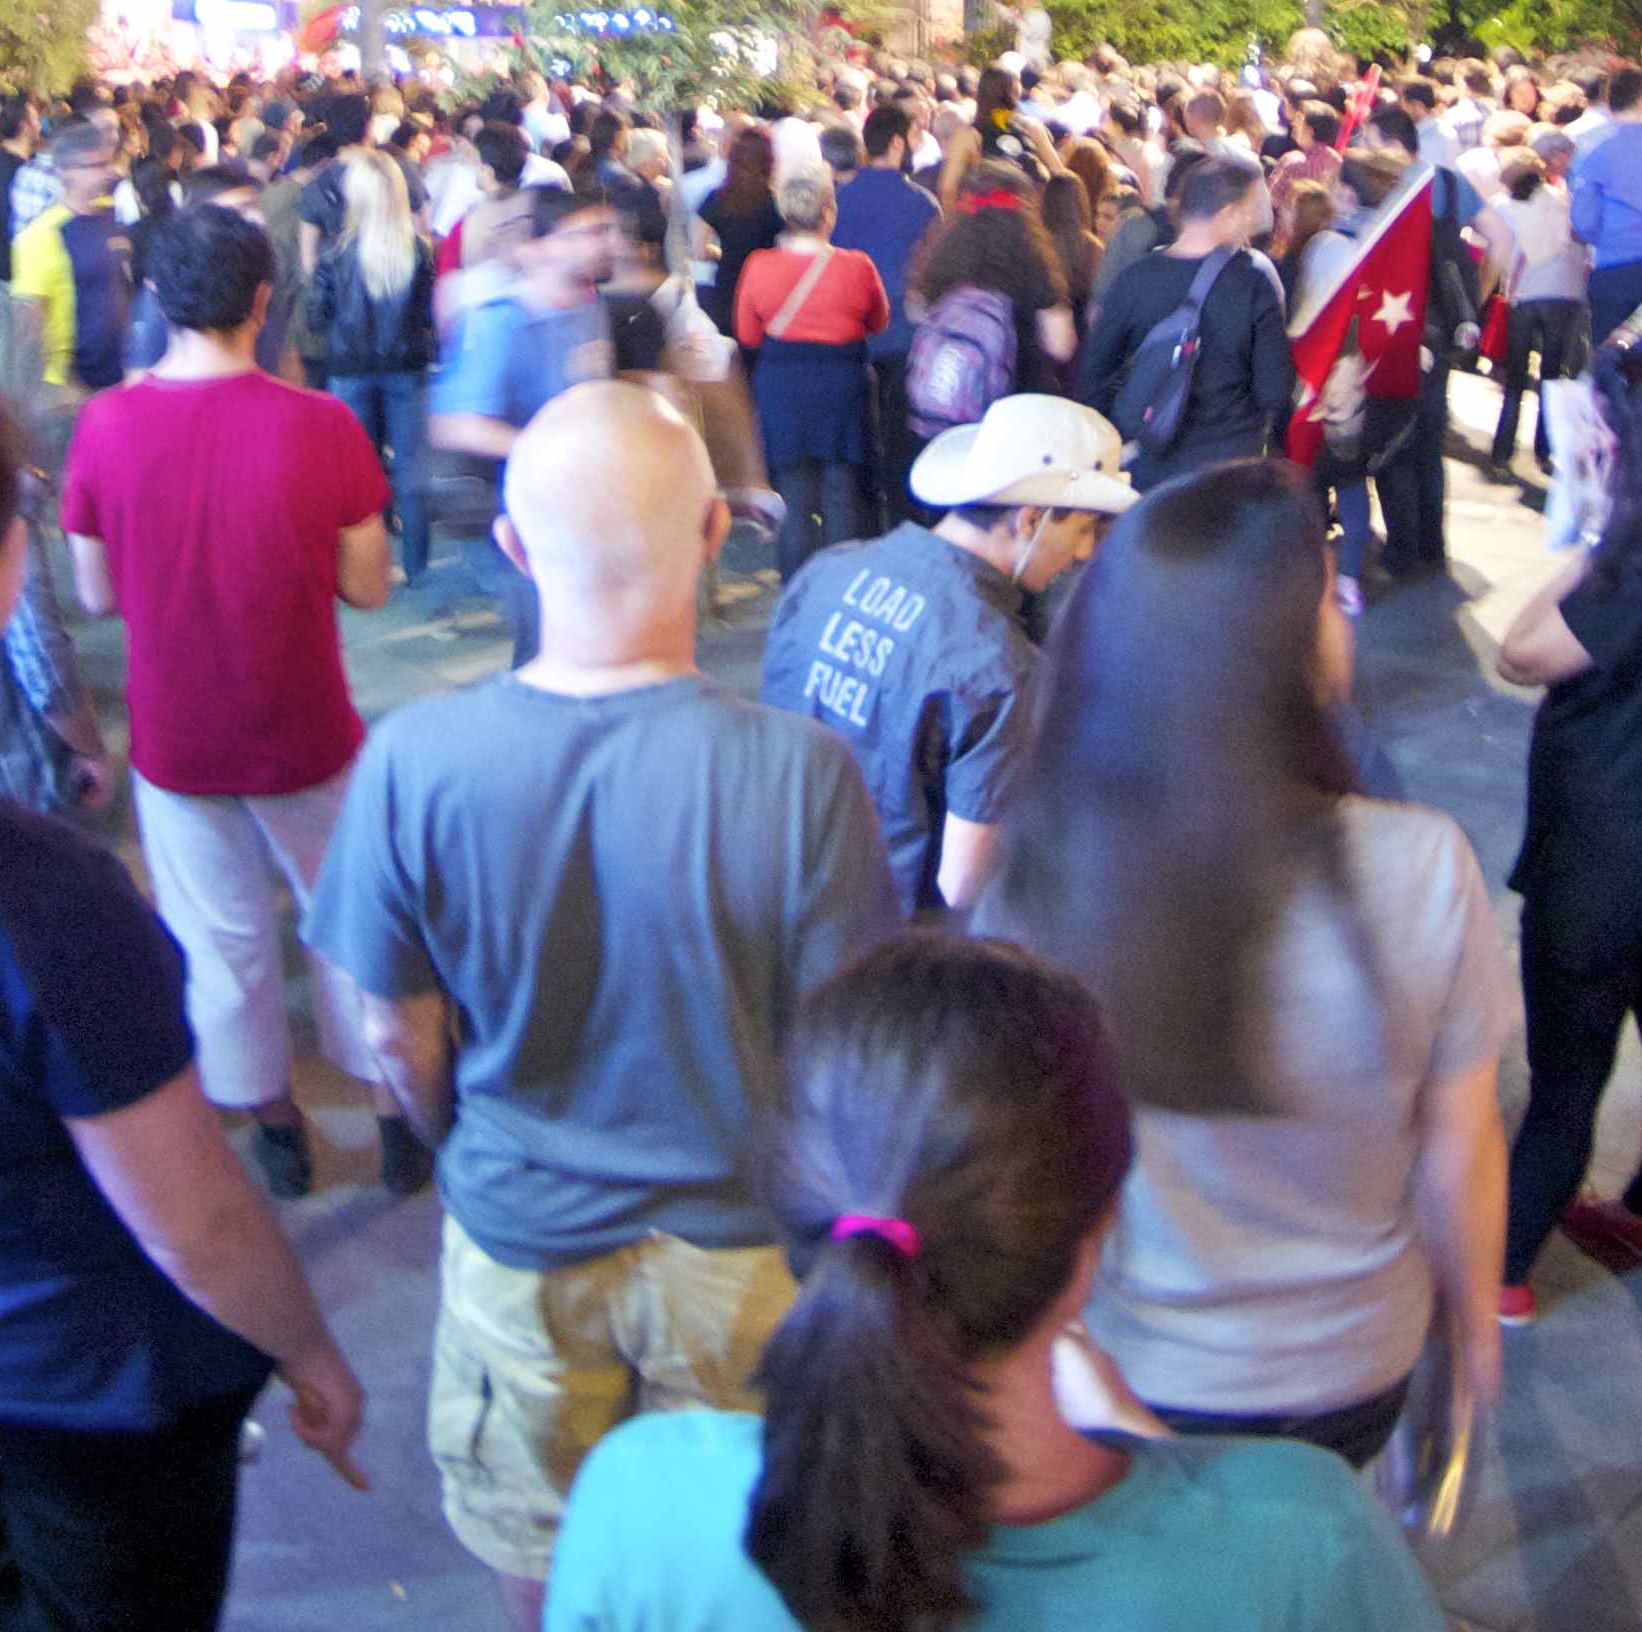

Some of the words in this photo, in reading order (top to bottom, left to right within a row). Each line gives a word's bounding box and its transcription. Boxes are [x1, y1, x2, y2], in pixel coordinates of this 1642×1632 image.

[843, 568, 925, 632] LOAD
[819, 612, 895, 677] LESS
[804, 660, 869, 727] FUEL
